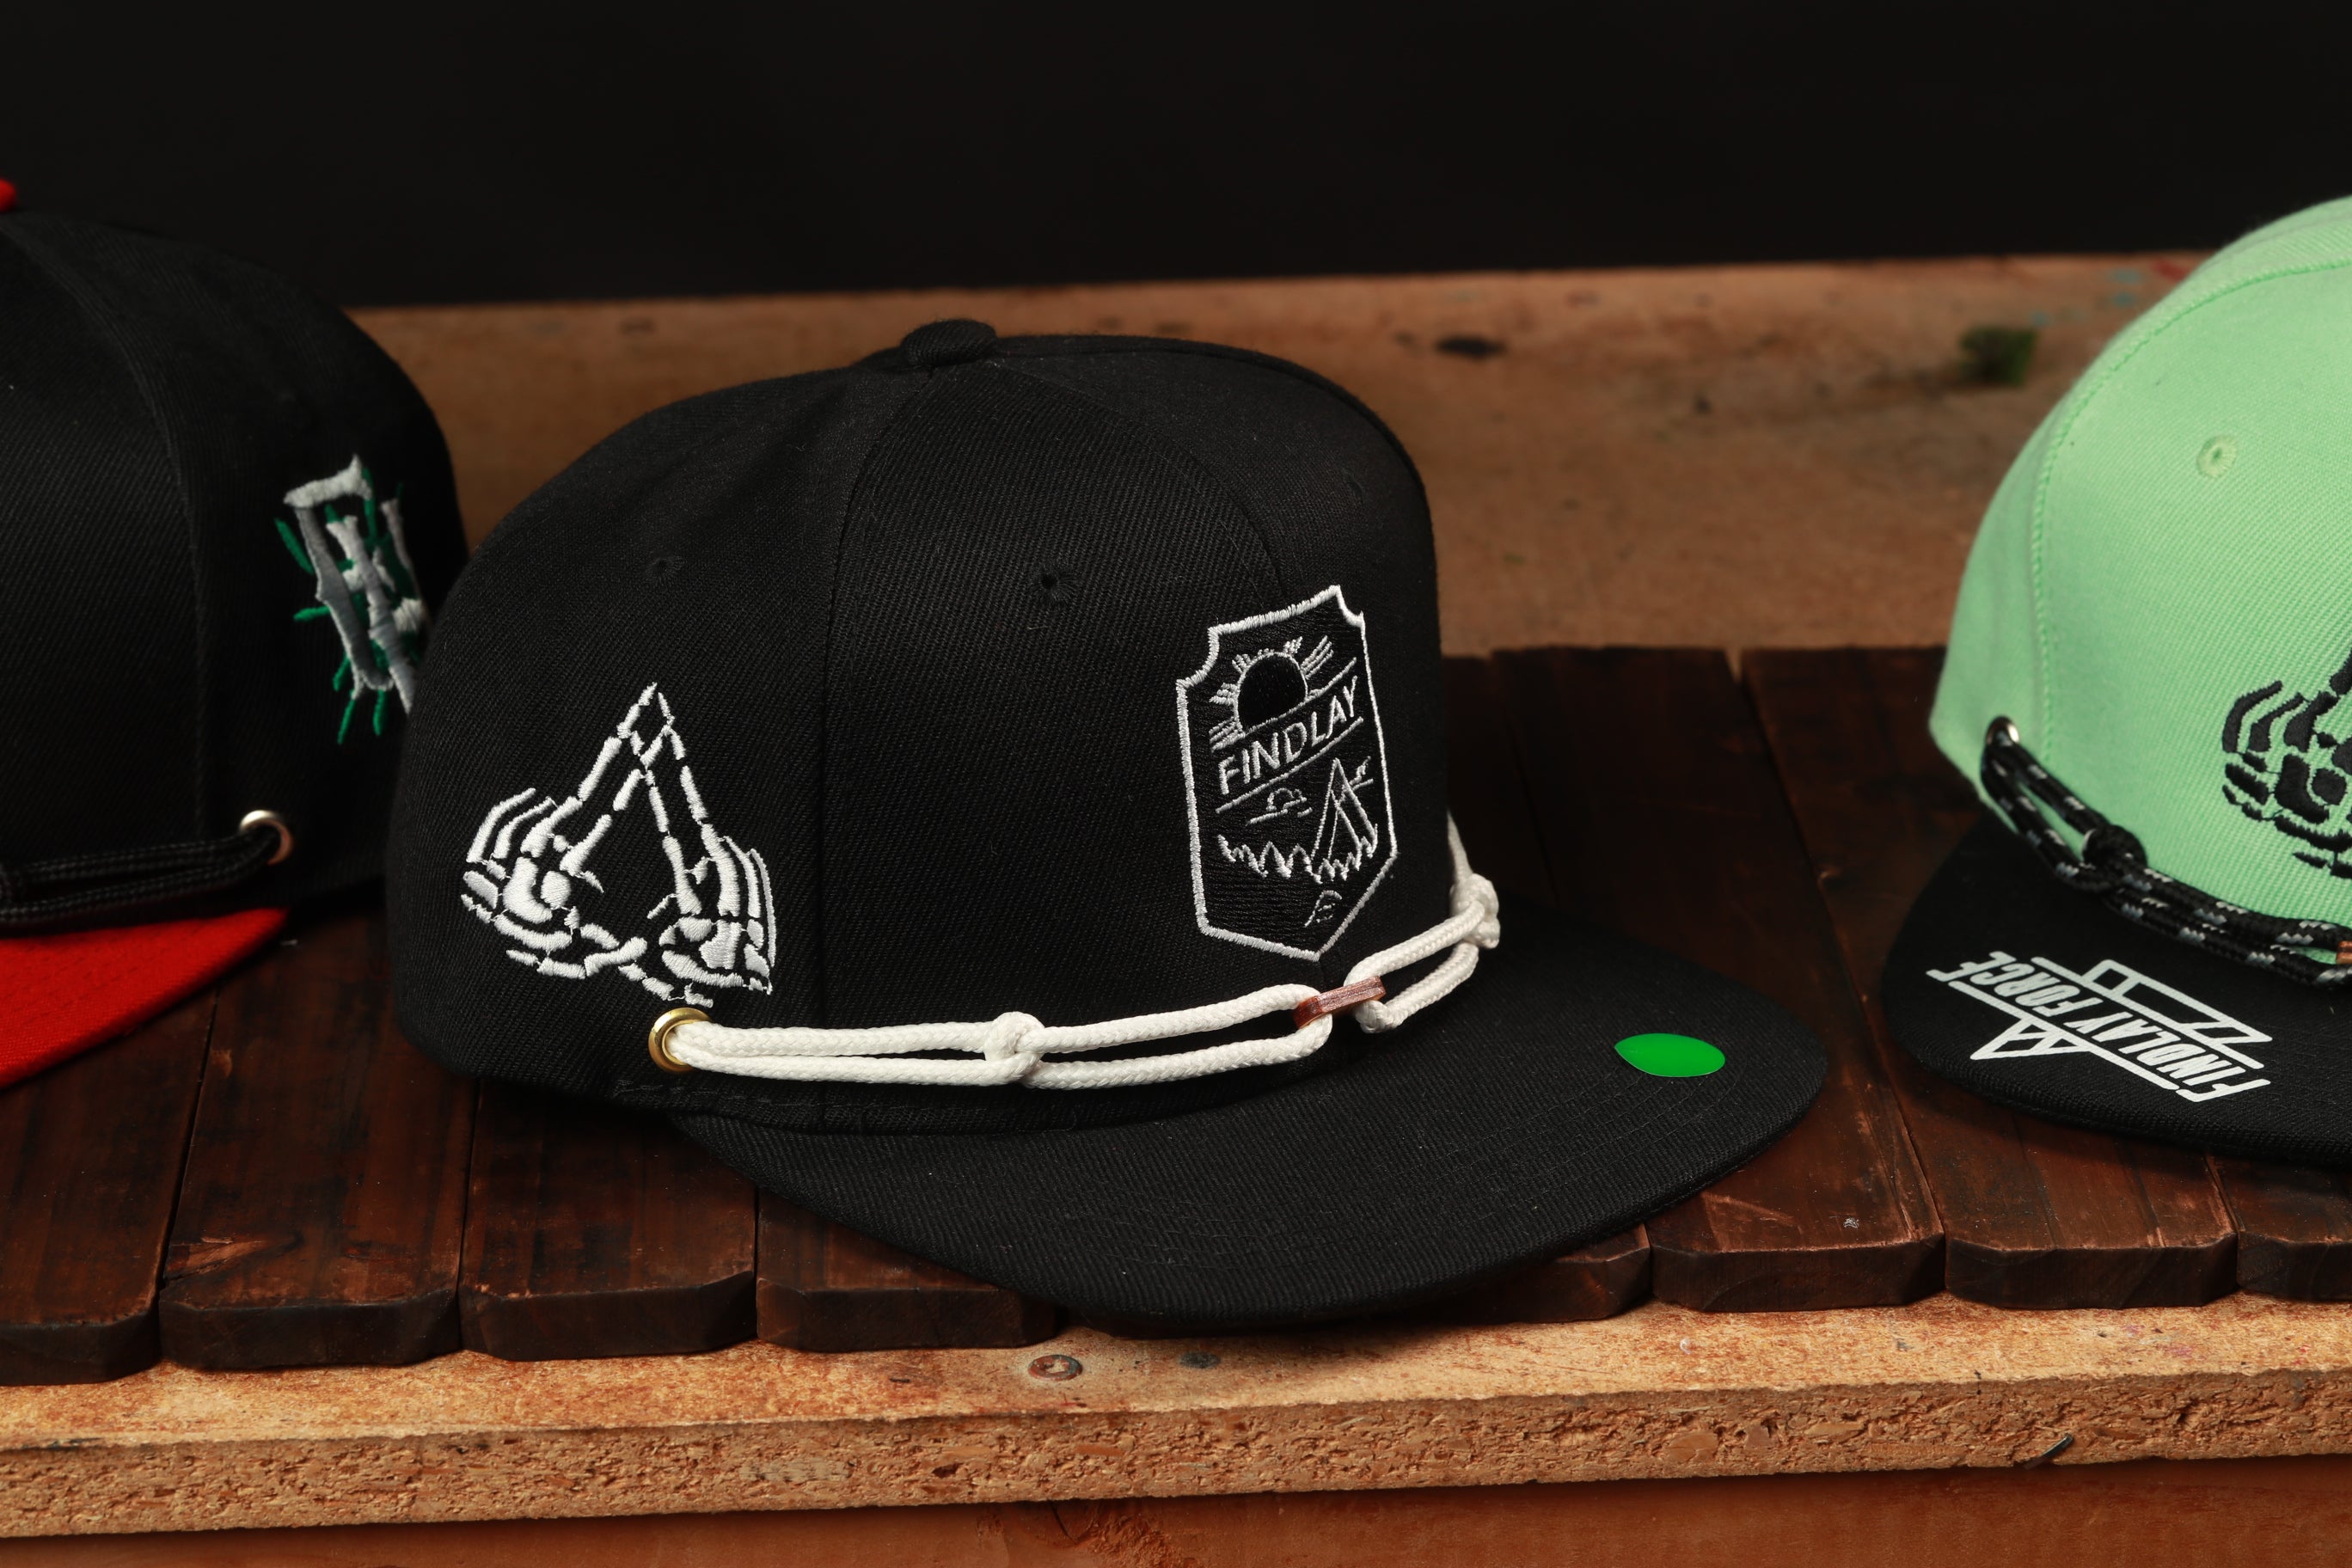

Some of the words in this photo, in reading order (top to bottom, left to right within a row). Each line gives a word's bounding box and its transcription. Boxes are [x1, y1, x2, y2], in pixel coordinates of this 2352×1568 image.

[1217, 676, 1358, 795] FINDLAY
[1926, 951, 2104, 1018] FORCE
[2063, 1011, 2271, 1103] FINDLAY
